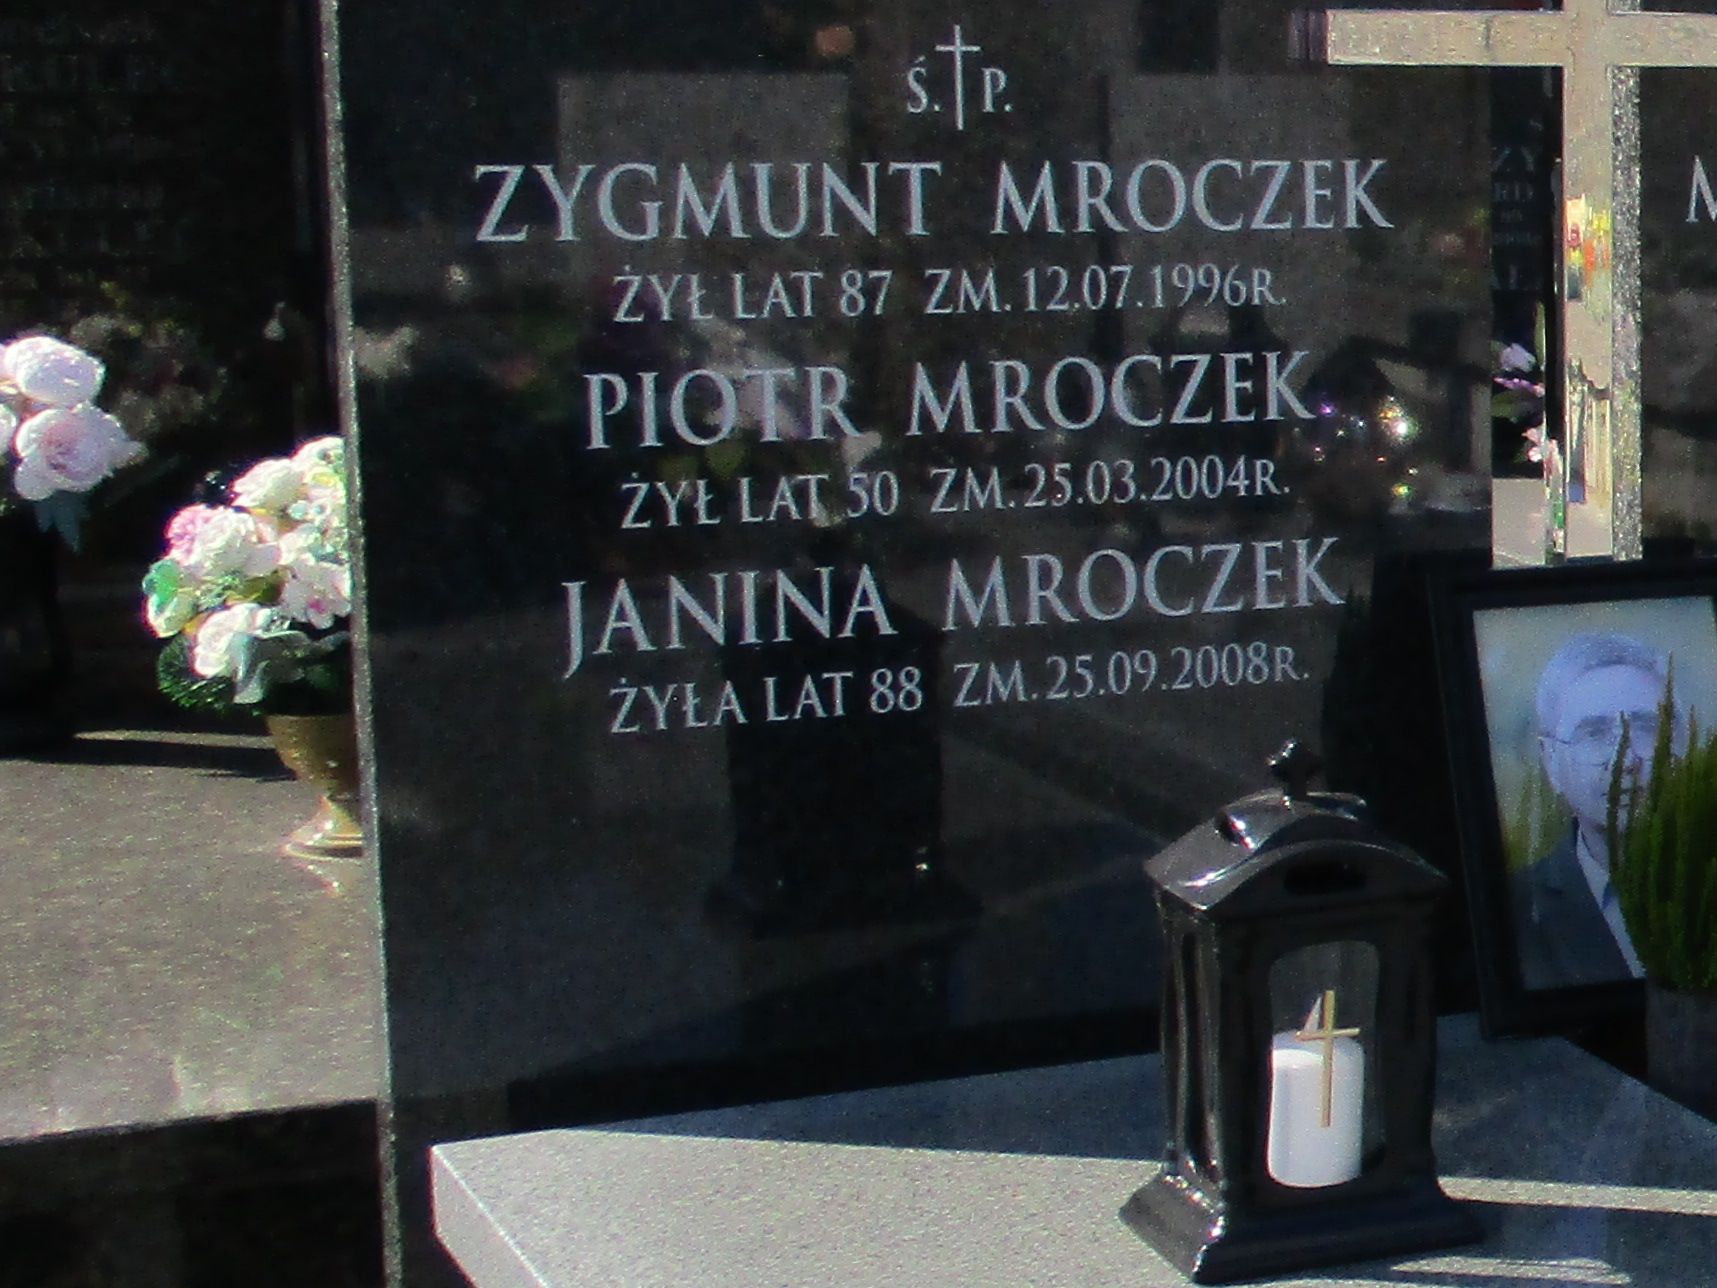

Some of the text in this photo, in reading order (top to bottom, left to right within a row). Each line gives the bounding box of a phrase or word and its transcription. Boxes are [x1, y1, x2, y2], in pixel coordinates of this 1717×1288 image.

[475, 159, 1394, 241] ZYGMUNT MROCZEK
[614, 266, 712, 322] ŻYŁ
[733, 272, 823, 318] LAT
[840, 270, 892, 316] 87
[584, 351, 1315, 450] PIOTR MROCZEK
[622, 473, 720, 528] ŻYŁ
[740, 474, 829, 523] LAT
[847, 468, 898, 517] 50
[562, 537, 1344, 680] JANINA MROCZEK
[610, 678, 747, 732] ŻYŁA
[765, 672, 853, 721] LAT
[870, 666, 922, 713] 88
